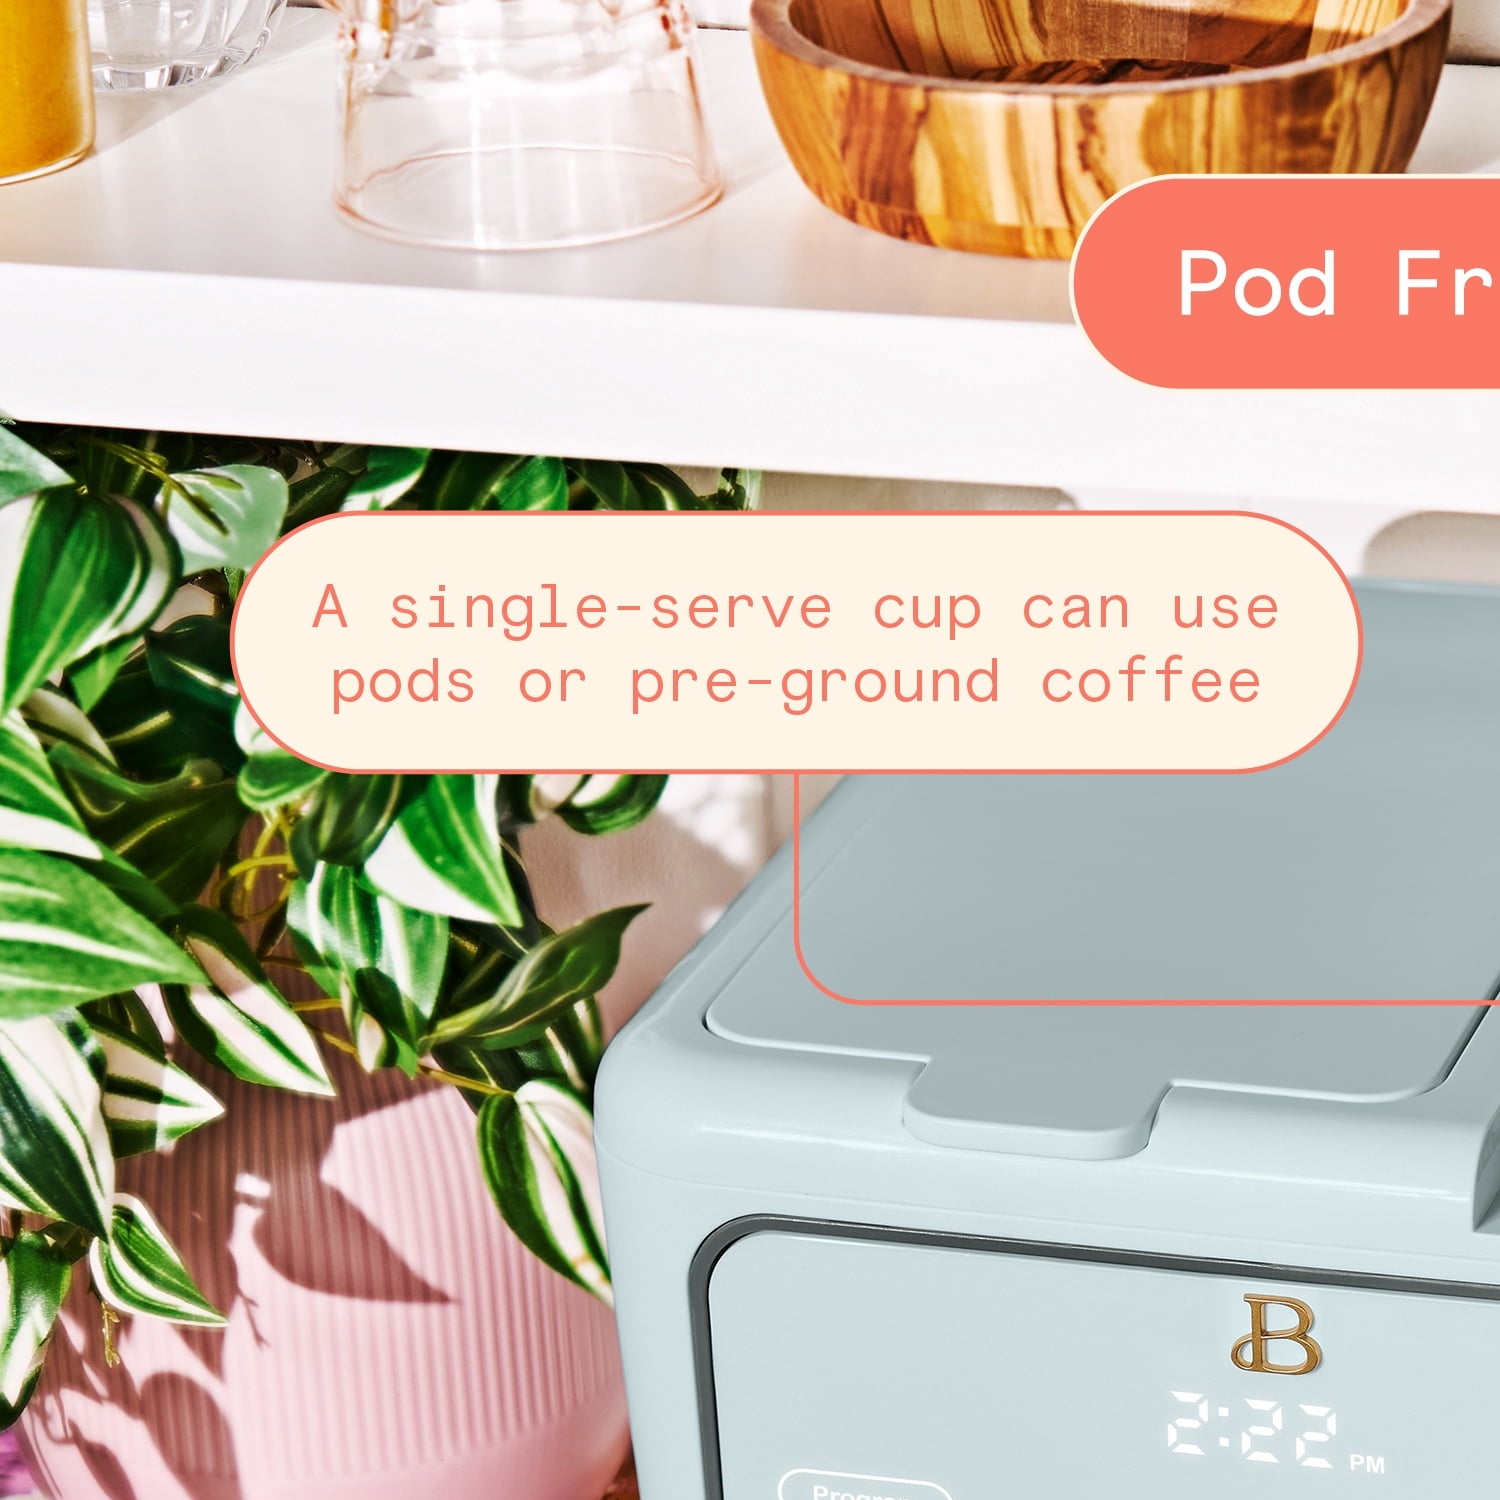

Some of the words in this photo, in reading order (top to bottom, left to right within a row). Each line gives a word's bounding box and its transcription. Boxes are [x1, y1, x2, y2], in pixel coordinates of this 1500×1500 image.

[1230, 1292, 1324, 1375] B
[1167, 1390, 1337, 1469] 2:22
[1349, 1453, 1386, 1475] PM
